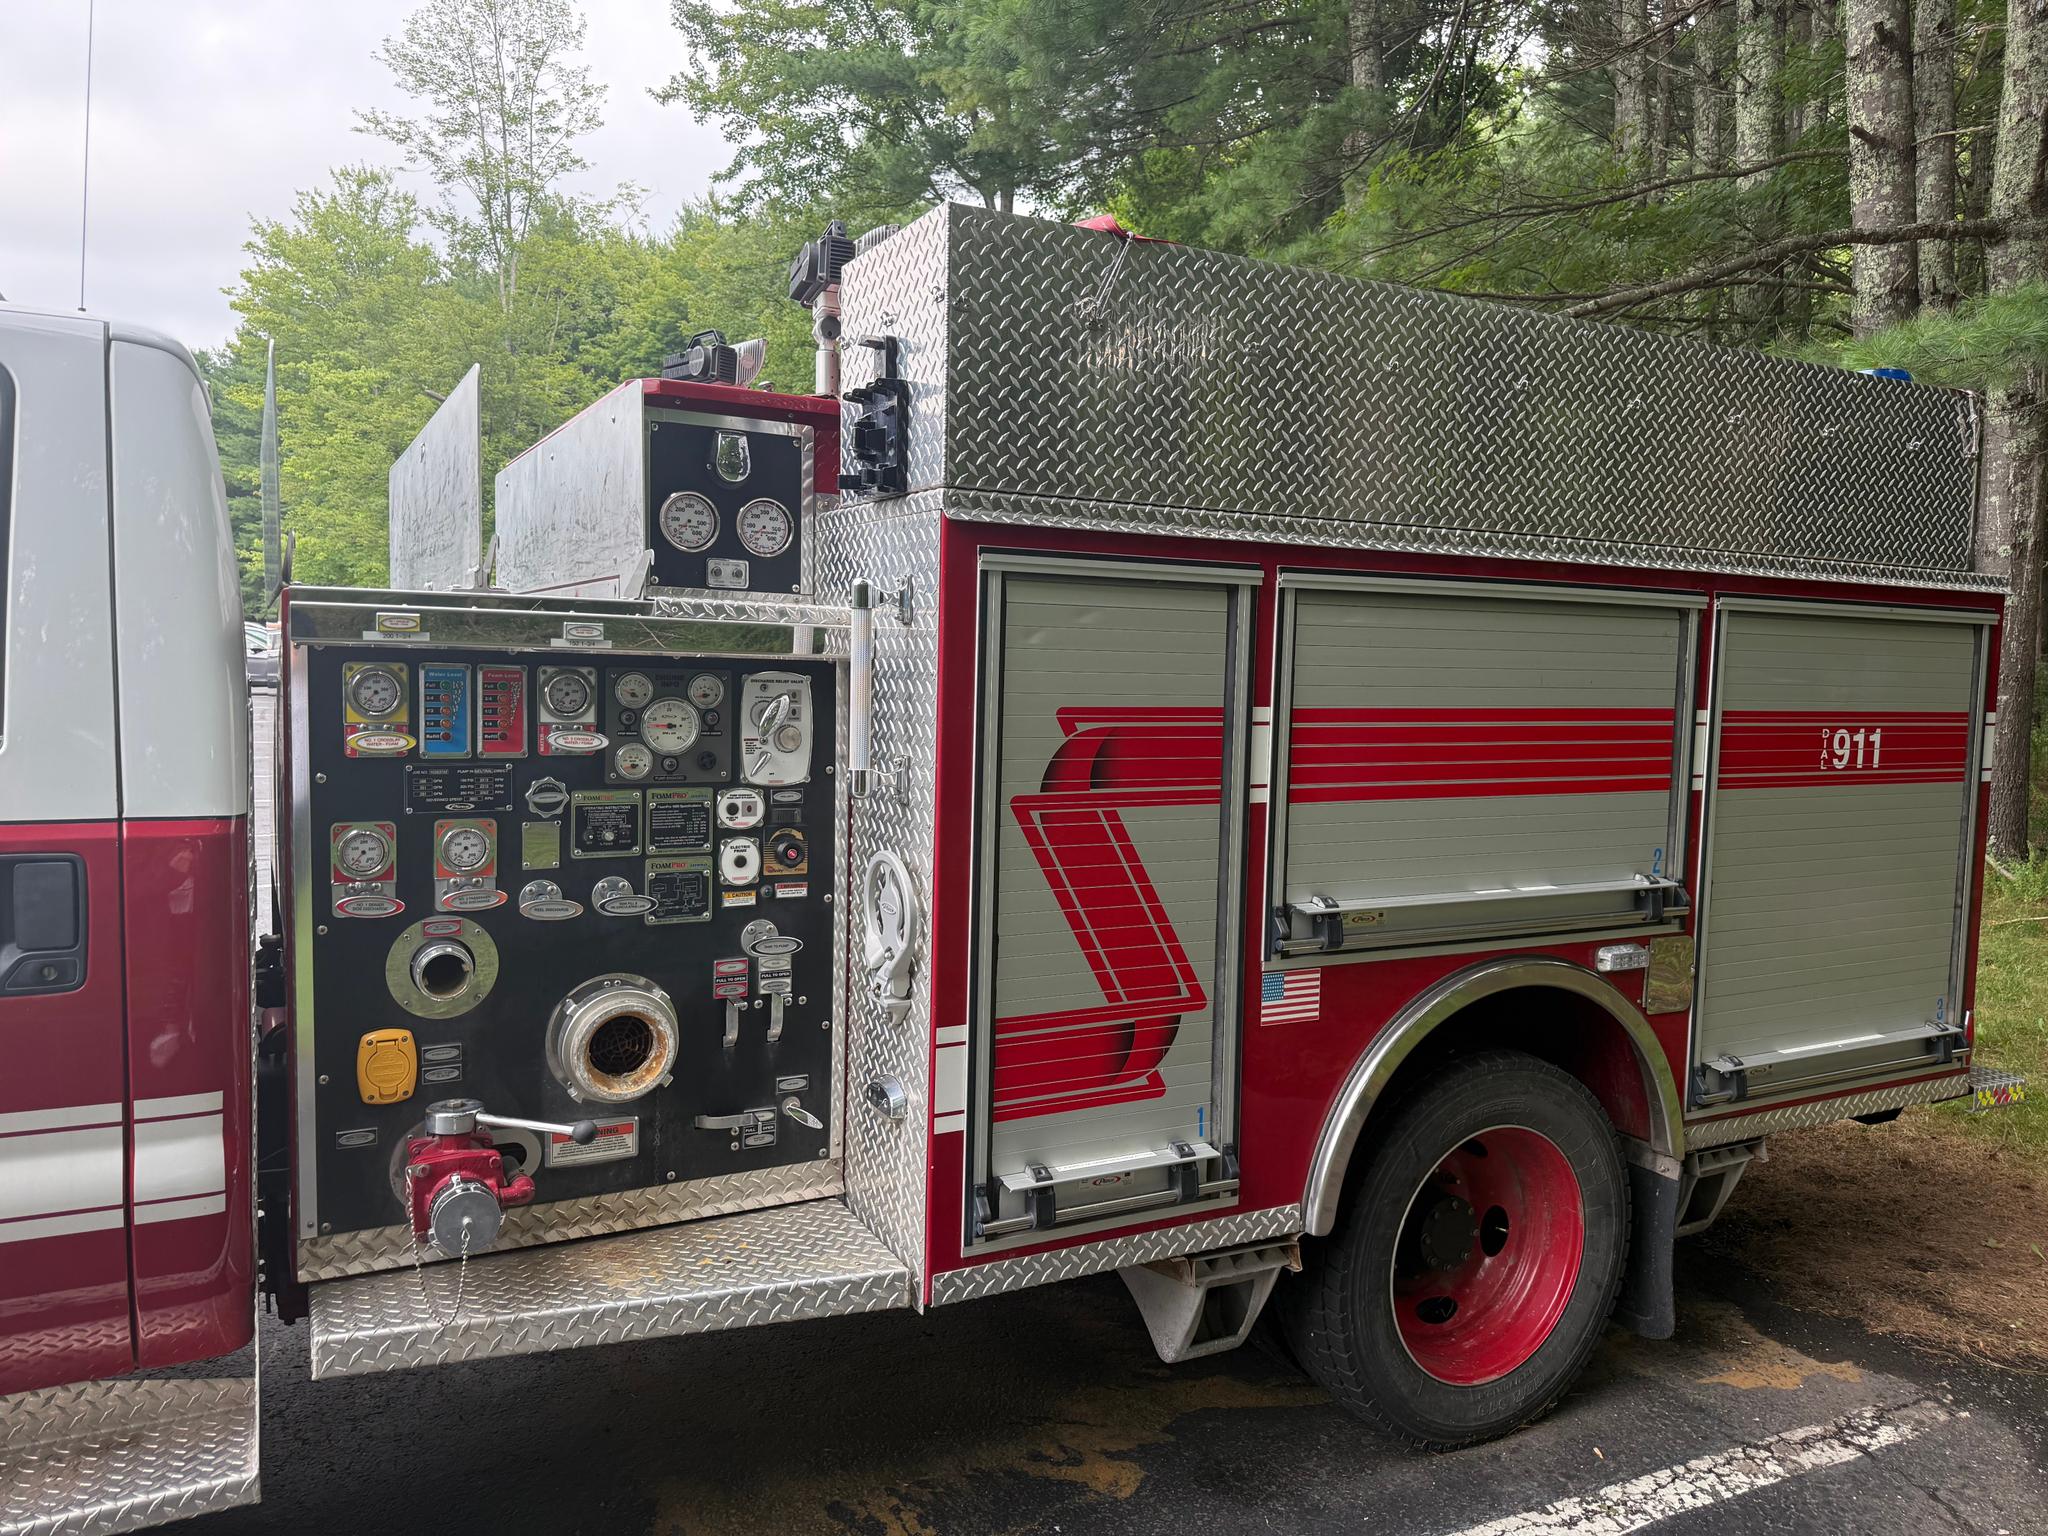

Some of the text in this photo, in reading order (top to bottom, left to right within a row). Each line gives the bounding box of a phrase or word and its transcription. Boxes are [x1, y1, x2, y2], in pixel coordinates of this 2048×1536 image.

[1820, 728, 1830, 770] DIAL
[1832, 727, 1882, 770] 911
[1652, 847, 1662, 874] 2
[1196, 1105, 1205, 1138] 1
